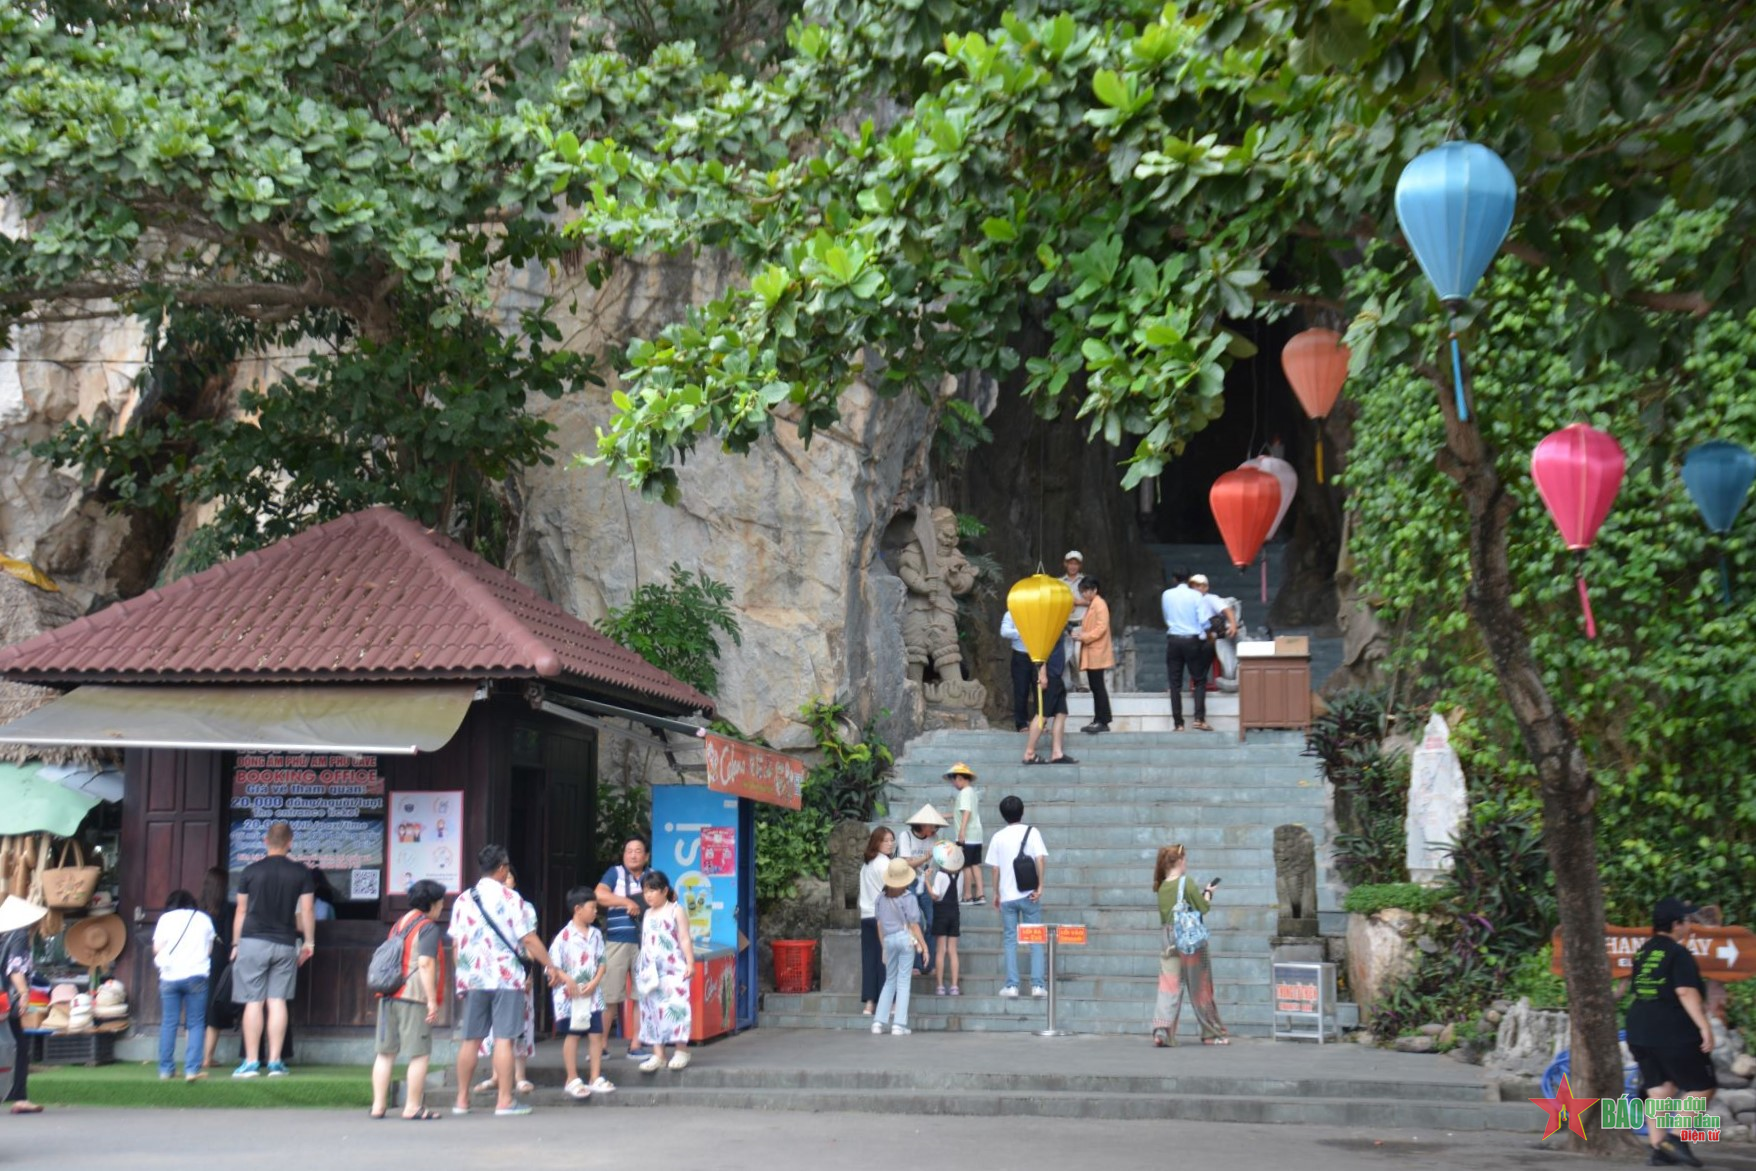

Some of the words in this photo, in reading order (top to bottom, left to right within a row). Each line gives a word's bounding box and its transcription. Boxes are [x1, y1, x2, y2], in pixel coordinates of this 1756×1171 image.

[236, 769, 315, 784] BOOKING
[319, 769, 377, 784] OFFICE
[290, 784, 326, 794] tham
[274, 808, 326, 817] entrance
